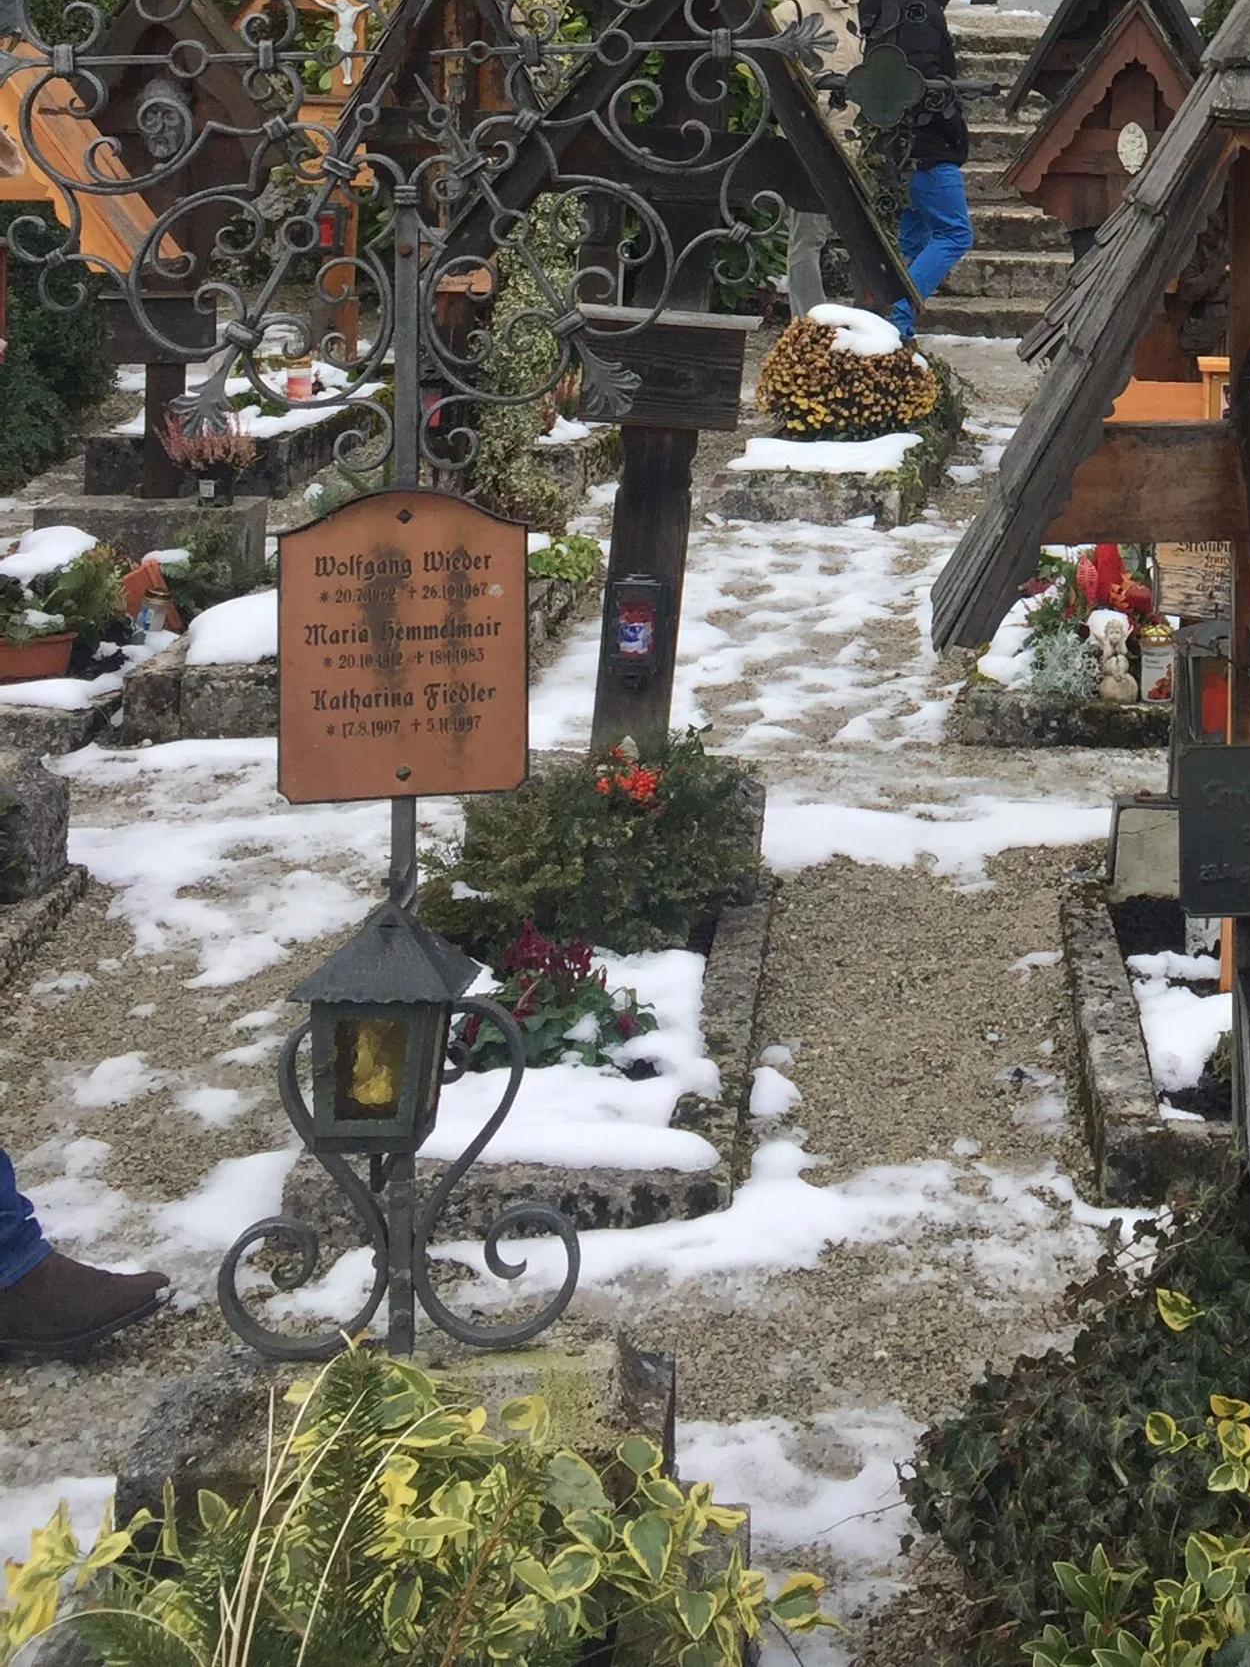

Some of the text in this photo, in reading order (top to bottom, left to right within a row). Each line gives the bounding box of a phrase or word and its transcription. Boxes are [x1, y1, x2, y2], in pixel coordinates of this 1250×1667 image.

[314, 550, 492, 580] Wolfgang Wieder
[304, 615, 501, 648] Maria Hemmelmair
[310, 682, 497, 714] Katharina Fiedler
